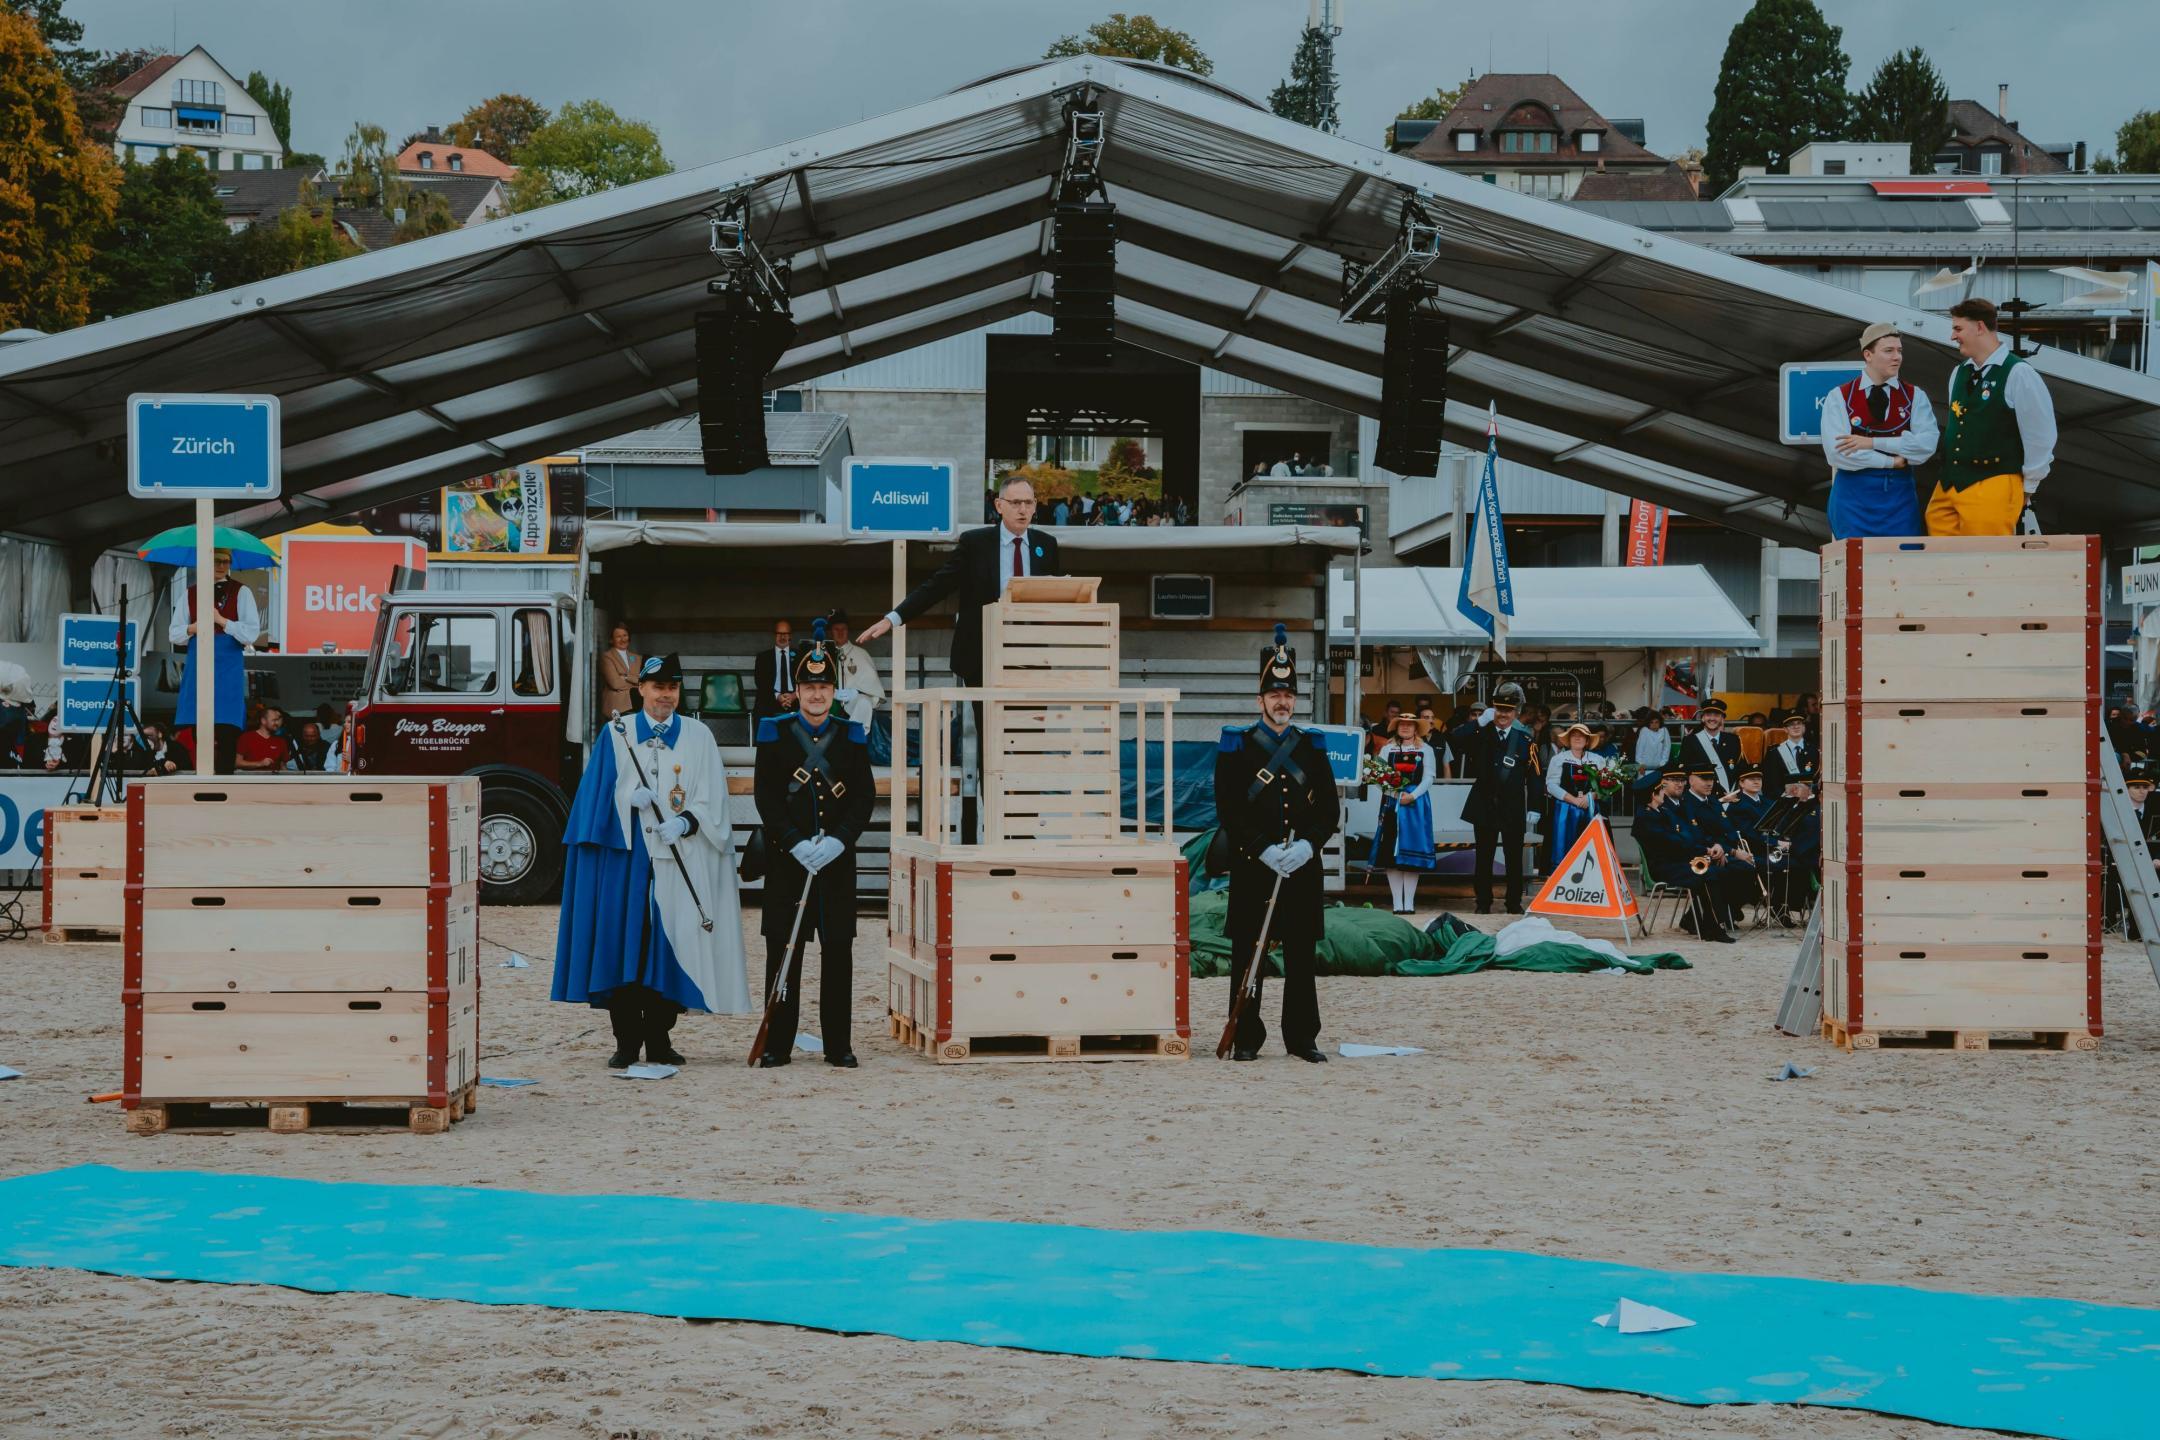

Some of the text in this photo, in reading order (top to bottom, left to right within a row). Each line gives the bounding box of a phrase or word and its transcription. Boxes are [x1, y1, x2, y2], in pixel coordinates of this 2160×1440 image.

[172, 436, 235, 454] Zürich
[871, 490, 929, 505] Adliswil
[524, 470, 541, 547] Appenzeller
[1496, 558, 1507, 584] Zürich
[305, 584, 378, 612] Blick
[394, 718, 486, 736] Jürg Biegger
[411, 737, 470, 745] ZIEGELBRÜCKE
[1554, 886, 1605, 904] Polizei
